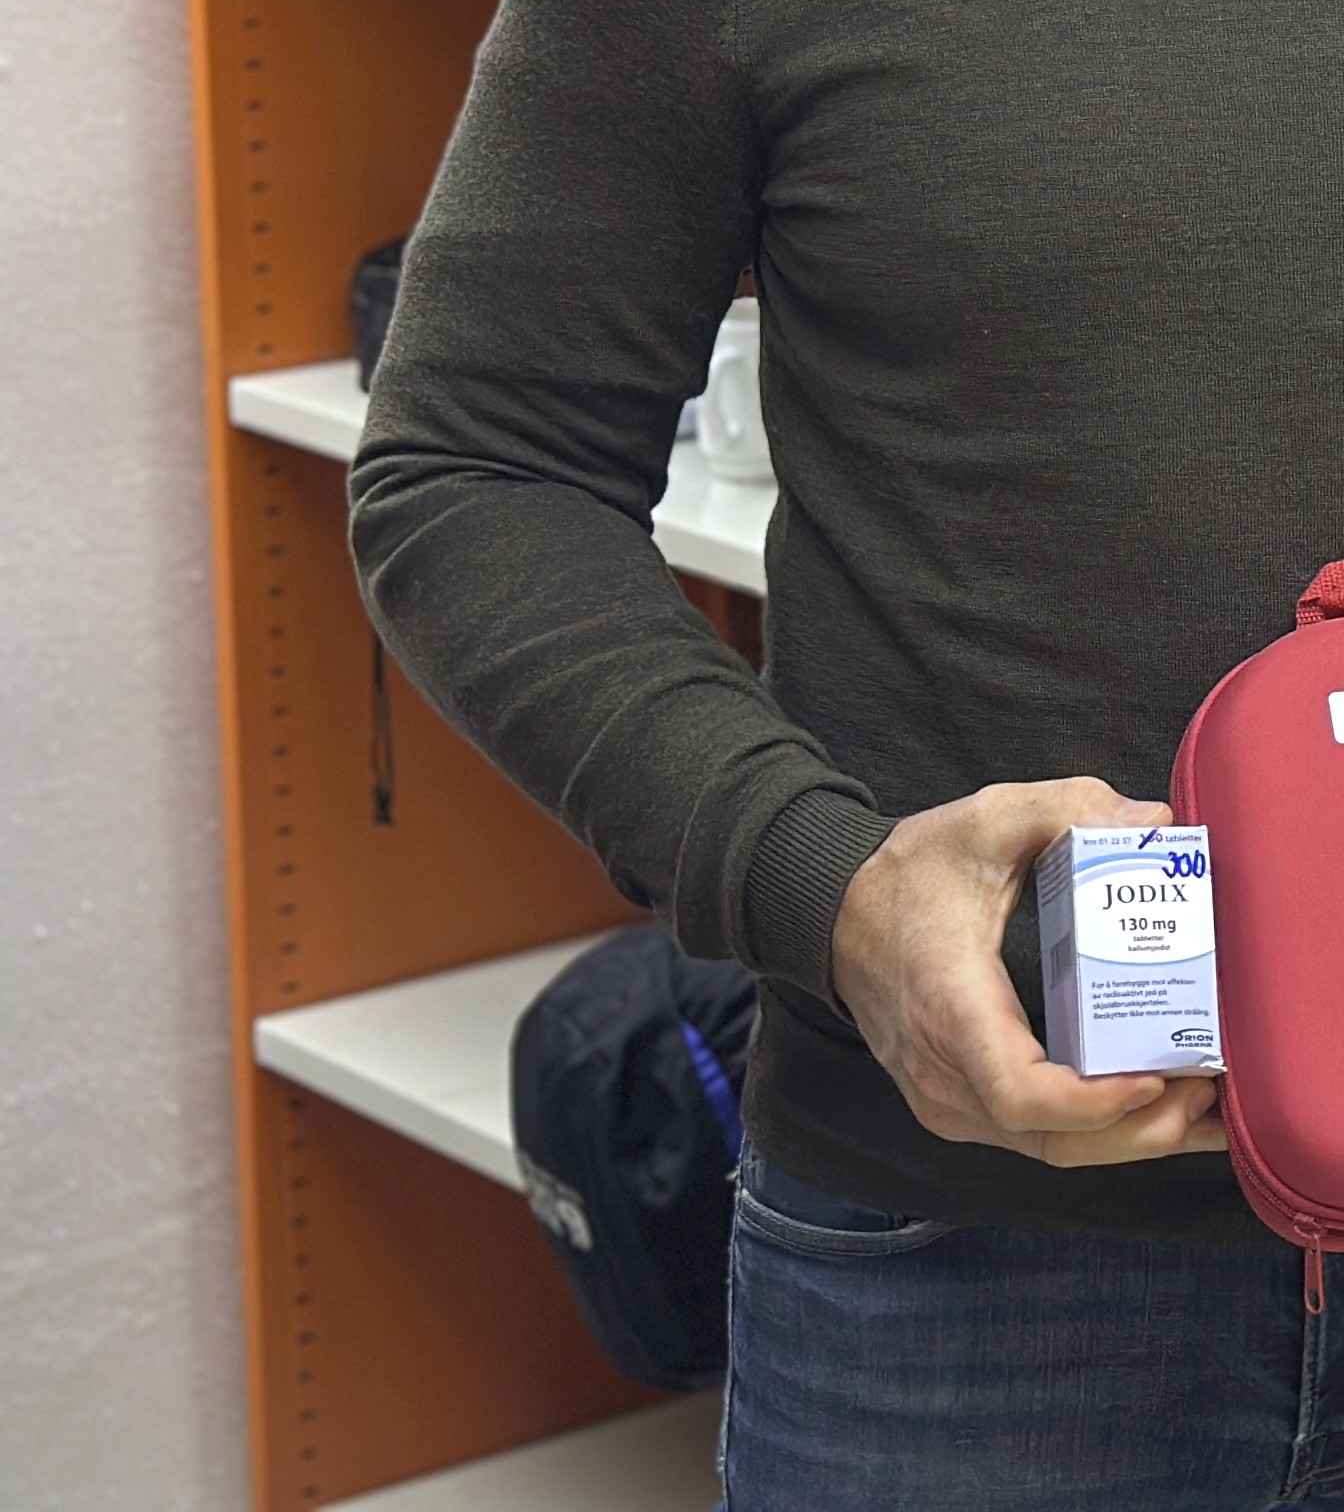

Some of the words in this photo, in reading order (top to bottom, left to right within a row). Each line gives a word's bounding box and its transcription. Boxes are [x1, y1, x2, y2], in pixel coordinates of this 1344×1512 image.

[1162, 849, 1206, 879] 300
[1102, 883, 1190, 910] JODIX
[1118, 917, 1148, 932] 130
[1152, 919, 1177, 934] mg
[1170, 1028, 1214, 1042] ORION
